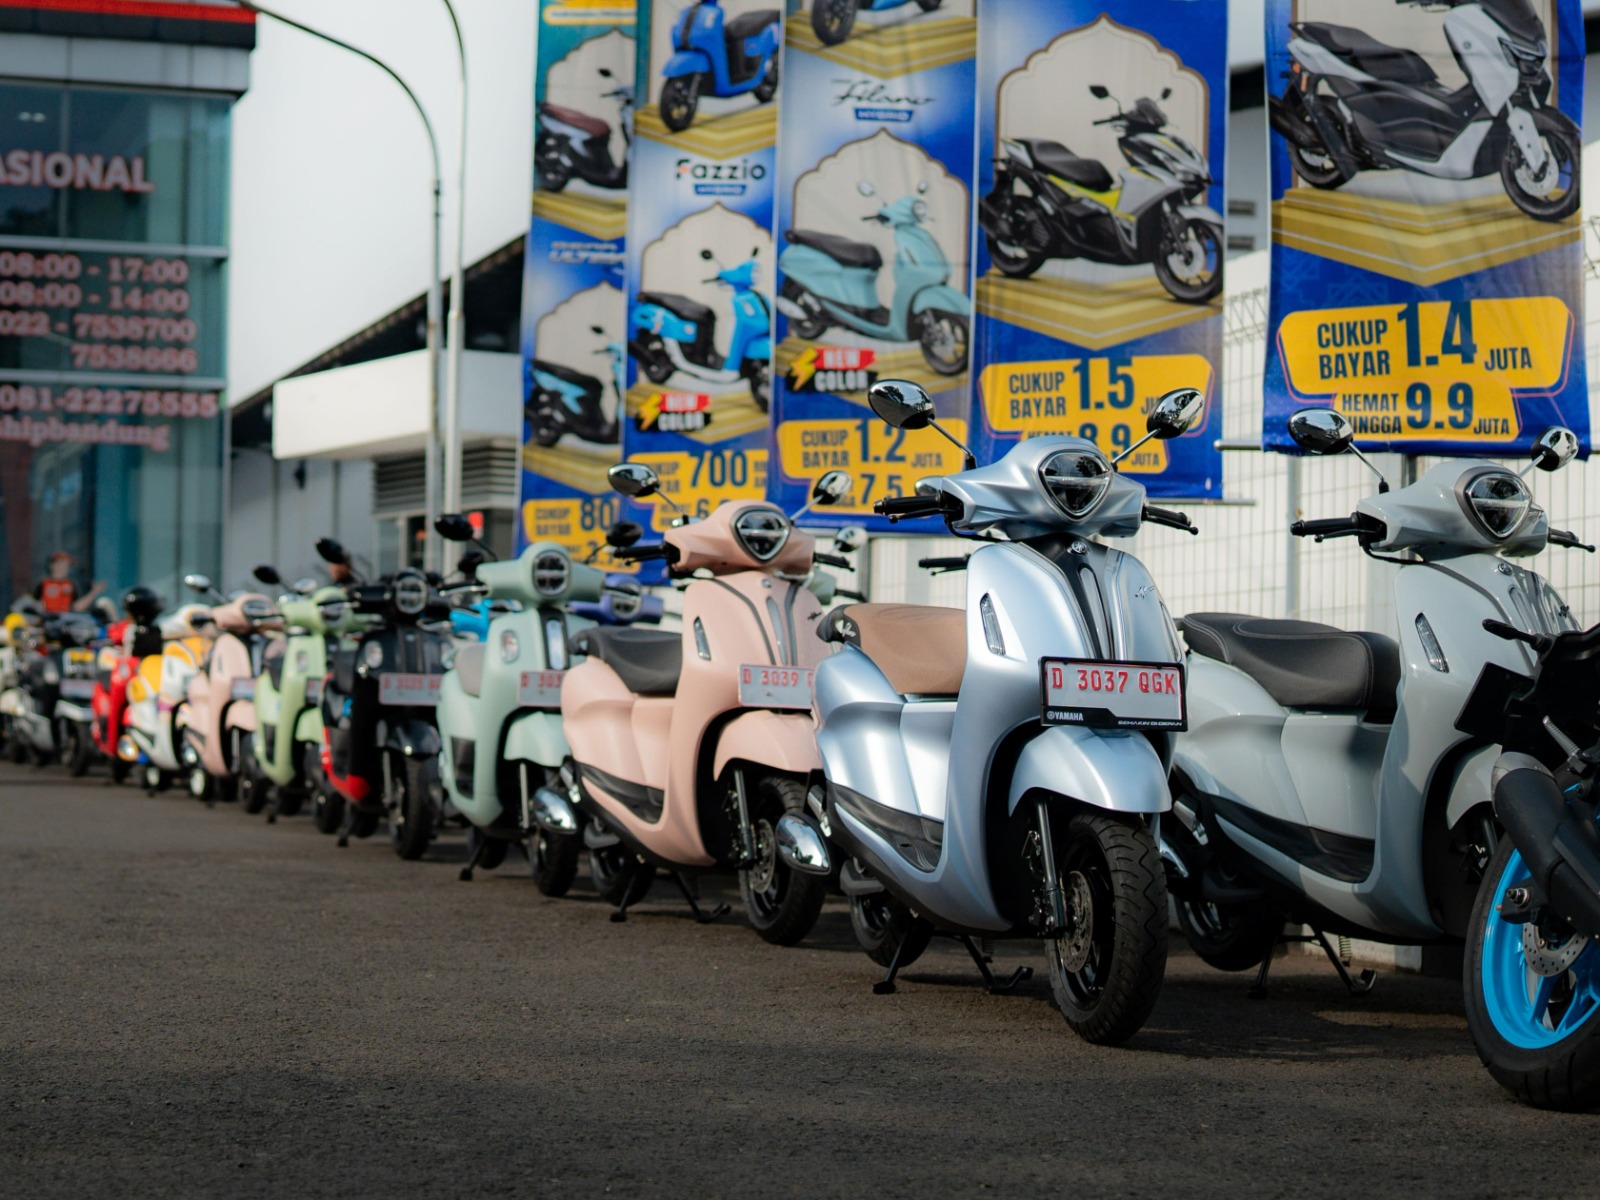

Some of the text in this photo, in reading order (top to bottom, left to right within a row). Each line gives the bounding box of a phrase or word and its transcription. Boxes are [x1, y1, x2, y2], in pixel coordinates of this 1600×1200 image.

[676, 159, 766, 180] Fazzio
[1317, 319, 1388, 348] CUKUP
[1397, 298, 1477, 367] 1.4
[823, 349, 861, 368] NEW
[1319, 347, 1532, 379] BAYAR JUTA
[814, 370, 869, 392] COLOR
[1009, 371, 1065, 394] CUKUP
[1073, 356, 1135, 410] 1.5
[1010, 397, 1066, 418] BAYAR
[1342, 393, 1399, 411] HEMAT
[1406, 382, 1474, 429] 9.9
[1474, 418, 1510, 435] JUTA
[802, 430, 848, 447] CUKUP
[856, 418, 906, 463] 1.2
[690, 451, 747, 487] 700
[803, 451, 942, 468] BAYAR JUTA
[1131, 453, 1160, 466] JUTA
[761, 670, 799, 686] 3039
[1052, 667, 1176, 695] D 3037 QGK
[1054, 711, 1084, 721] YAMAHA
